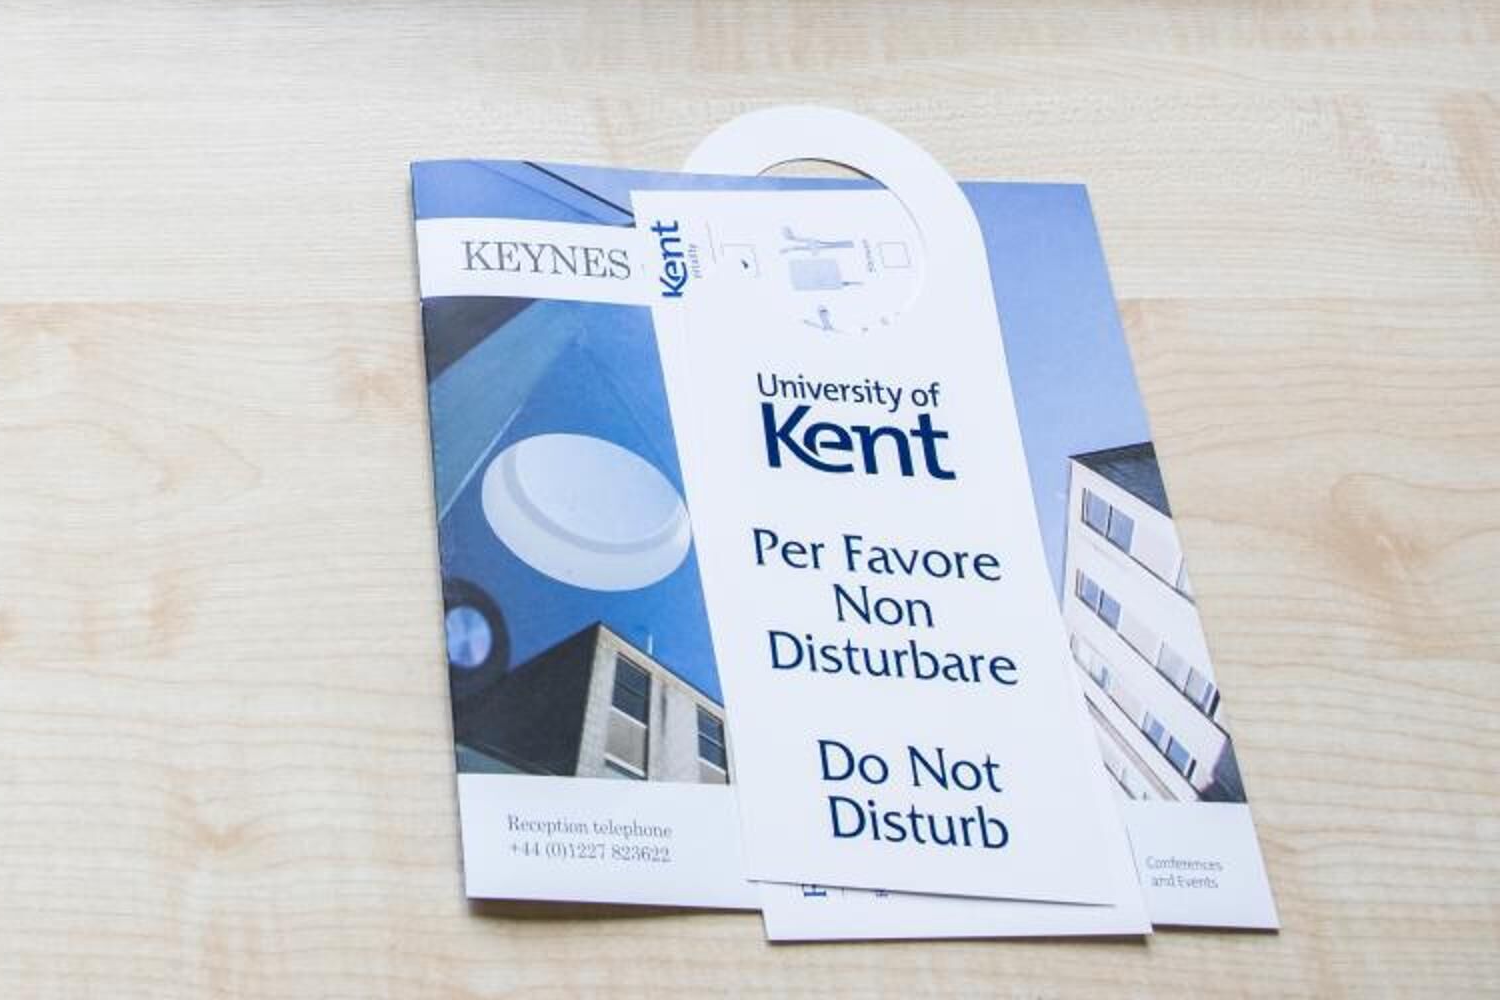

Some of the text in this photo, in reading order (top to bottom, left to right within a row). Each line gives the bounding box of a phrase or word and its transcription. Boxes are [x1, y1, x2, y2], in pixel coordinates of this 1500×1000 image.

[462, 241, 631, 281] KEYNES
[650, 220, 688, 297] Kent
[757, 372, 941, 412] University of
[761, 402, 957, 481] Kent
[752, 528, 1002, 581] Per Favore
[833, 583, 935, 628] Non
[768, 630, 1019, 685] Disturbare
[818, 740, 1003, 793] Do Not
[507, 814, 673, 839] Reception telephone
[828, 795, 1010, 849] Disturb
[511, 841, 672, 862] +44 (0)1227 823622
[1146, 855, 1224, 872] Conferences
[1151, 873, 1219, 889] and Events
